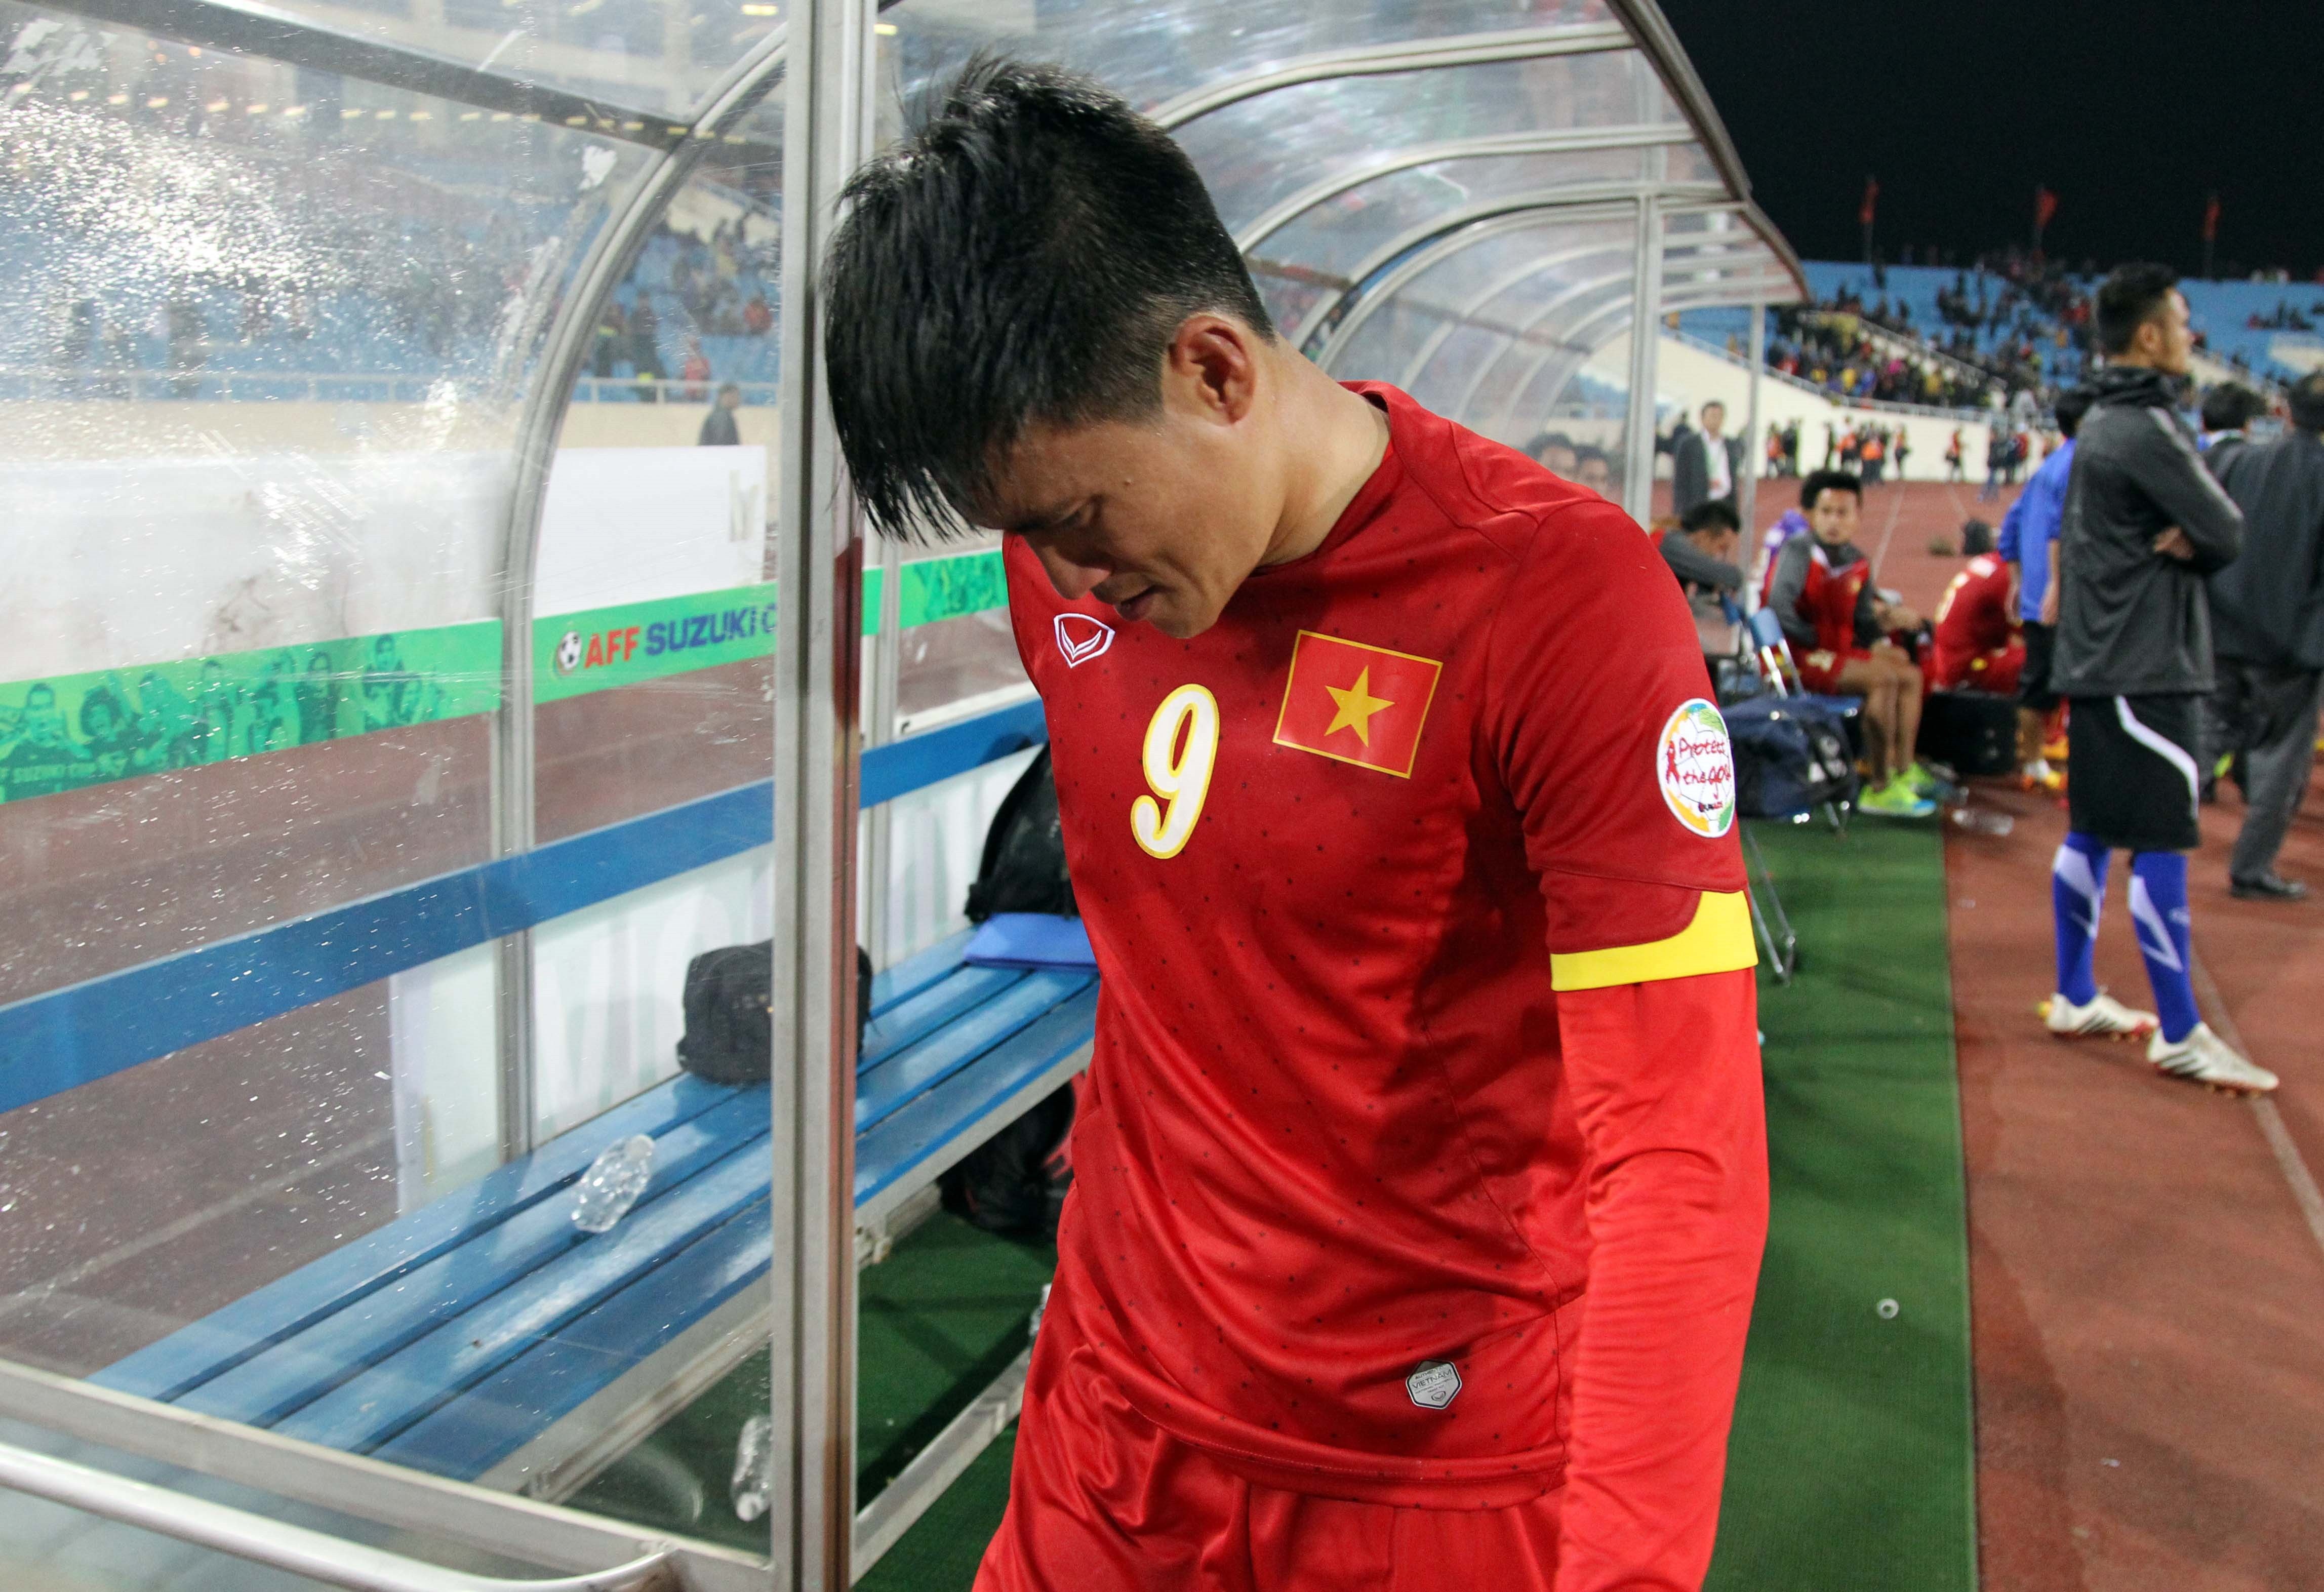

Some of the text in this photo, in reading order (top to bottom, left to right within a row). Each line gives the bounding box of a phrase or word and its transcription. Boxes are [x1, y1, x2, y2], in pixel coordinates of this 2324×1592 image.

[584, 625, 640, 669] AFF
[645, 607, 756, 656] SUZUKI
[1130, 684, 1220, 859] 9
[1412, 1369, 1452, 1389] VIETNAM
